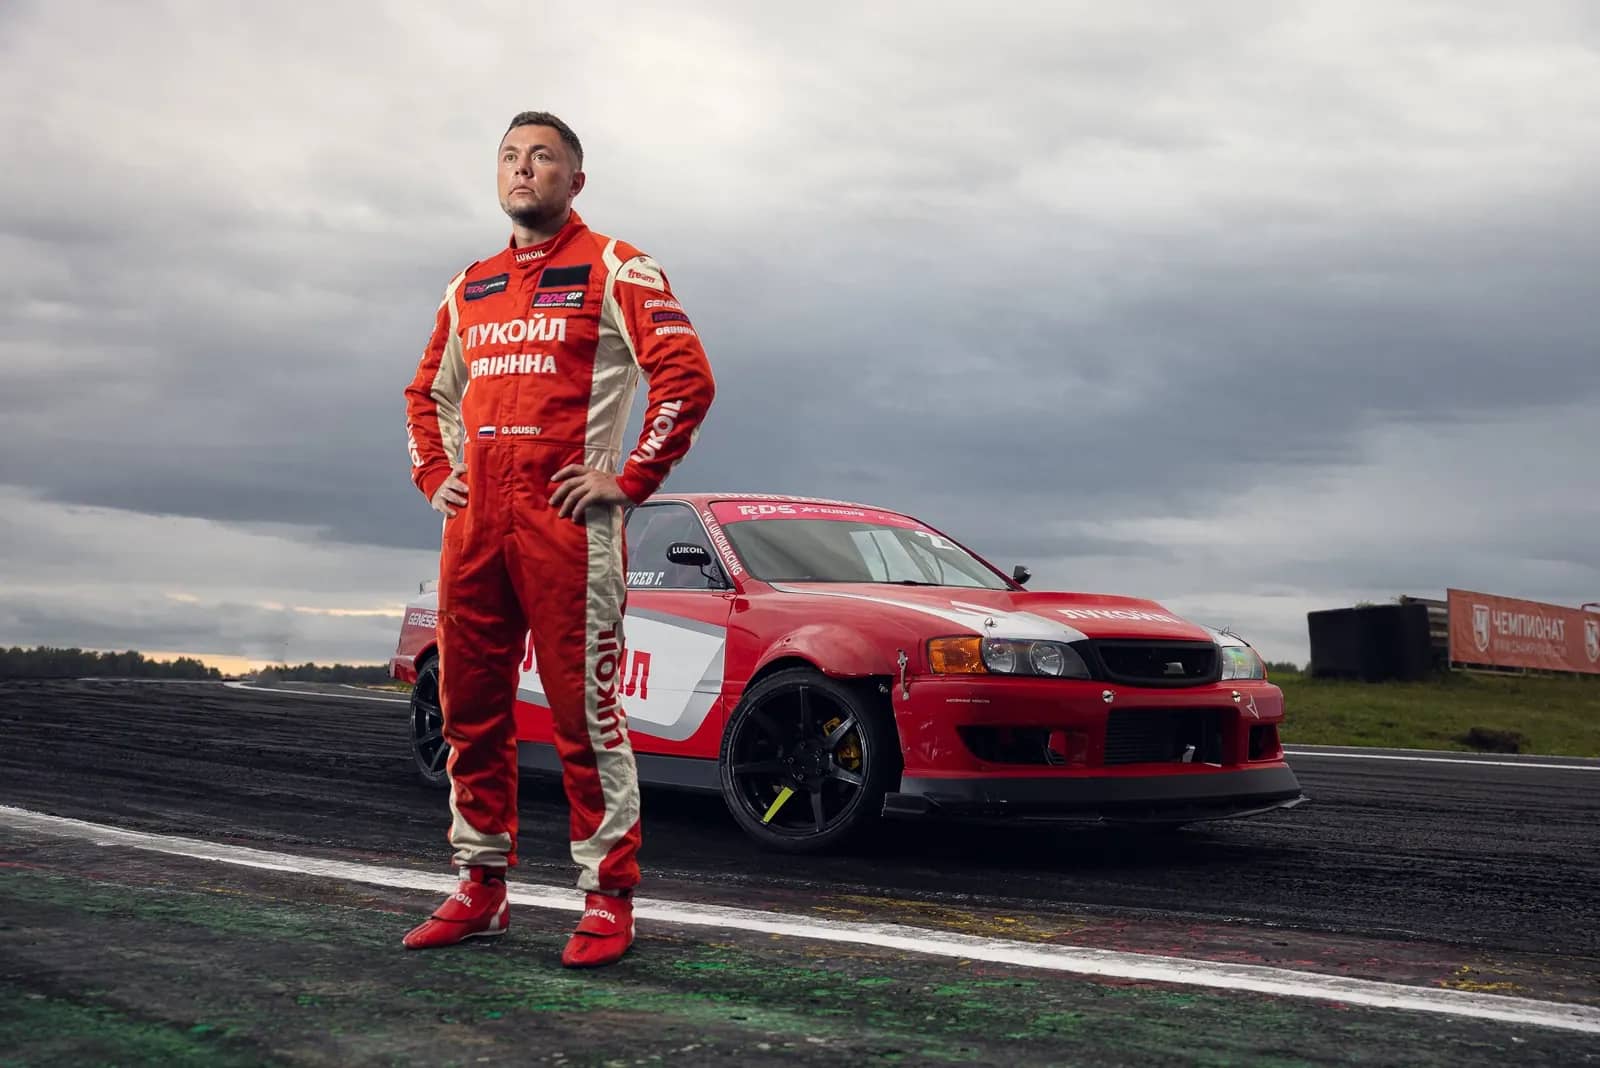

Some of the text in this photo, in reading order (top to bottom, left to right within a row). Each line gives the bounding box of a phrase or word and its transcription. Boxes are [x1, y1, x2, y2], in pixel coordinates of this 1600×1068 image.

[516, 250, 546, 262] LUKOIL
[466, 313, 567, 350] ЛУКОЙЛ
[631, 400, 683, 463] LUKOIL
[738, 505, 797, 515] RDS
[672, 546, 704, 554] LUKOIL
[1492, 609, 1565, 641] ЧЕМПИОНАТ
[597, 621, 624, 750] LUKOIL
